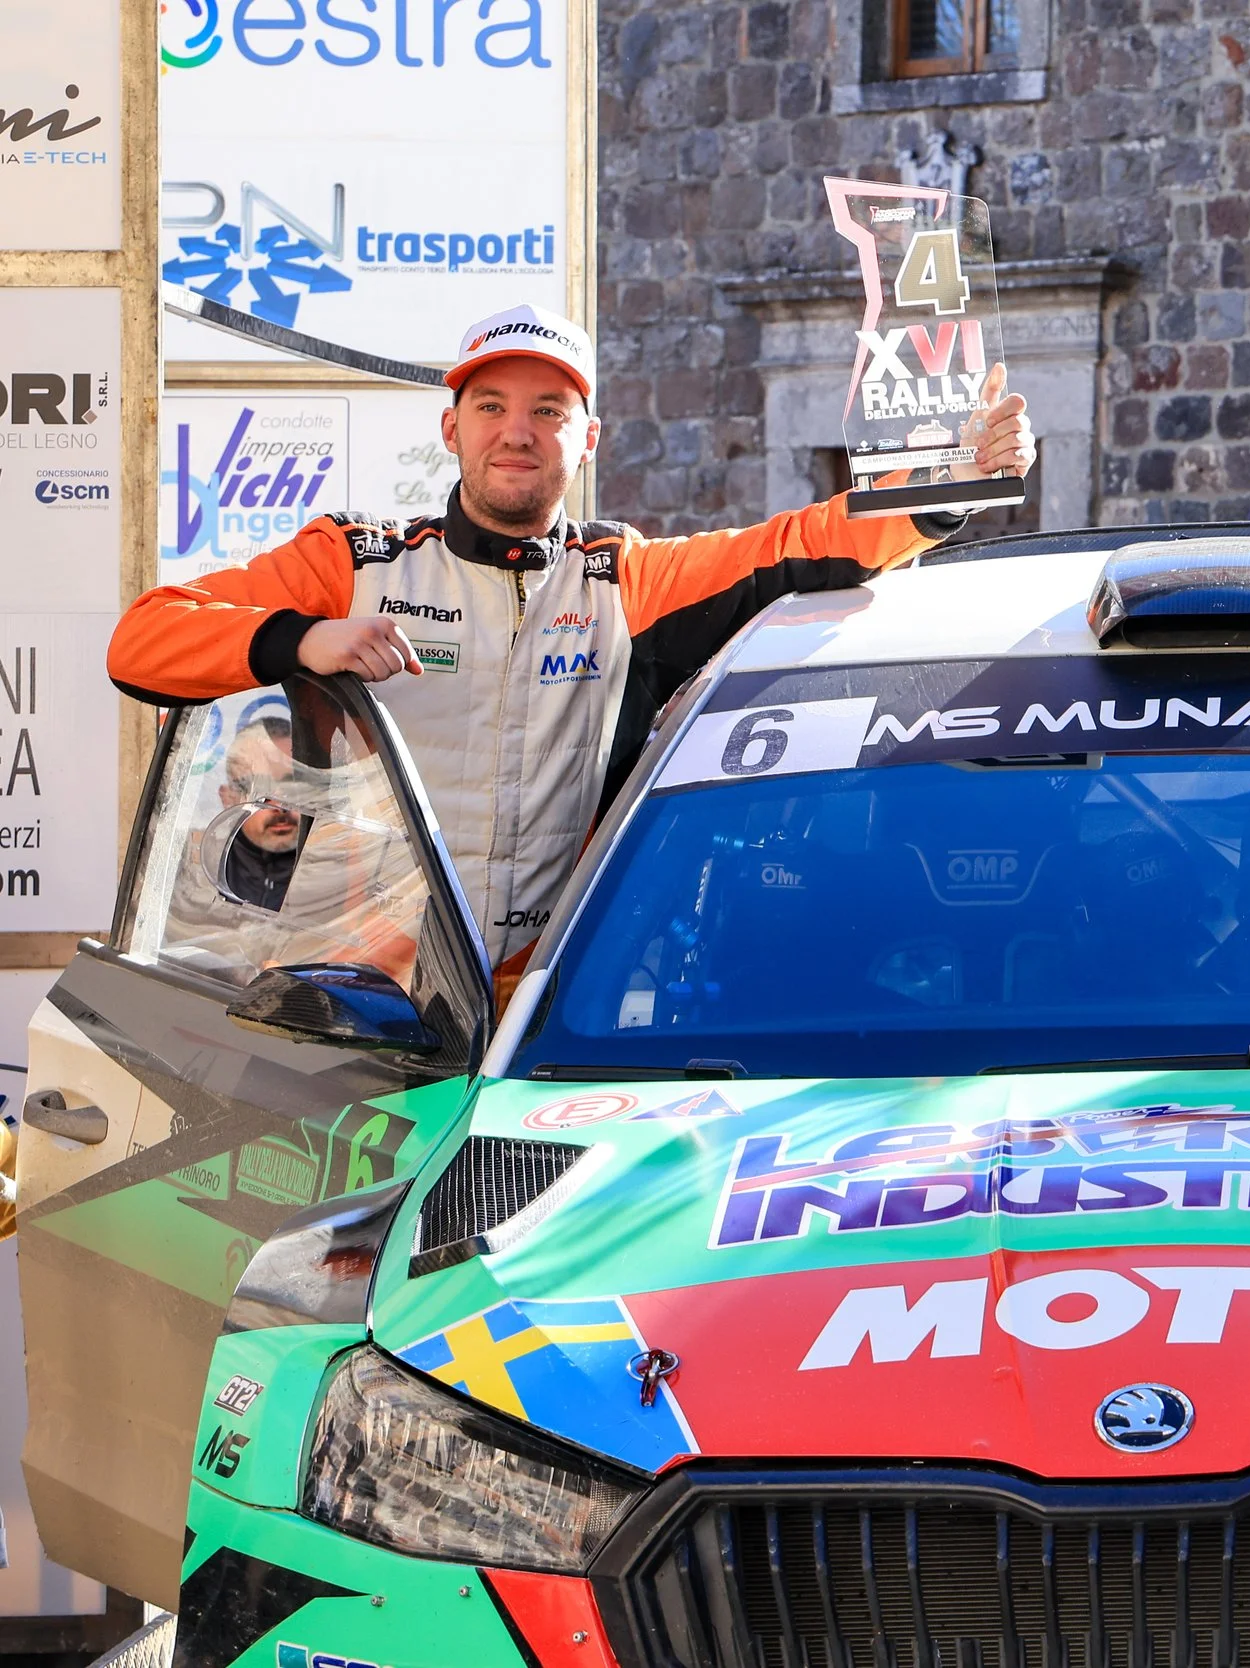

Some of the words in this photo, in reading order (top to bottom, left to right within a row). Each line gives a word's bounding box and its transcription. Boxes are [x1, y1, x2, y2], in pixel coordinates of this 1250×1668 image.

[232, 0, 553, 68] estra
[23, 152, 106, 164] E-TECH
[357, 225, 554, 272] trasporti
[894, 228, 970, 315] 4
[855, 319, 986, 383] XVI
[0, 373, 91, 425] RI
[98, 371, 108, 407] S.R.L.
[861, 372, 987, 413] RALLY
[260, 411, 334, 430] condotte
[864, 406, 905, 421] DELLA
[908, 403, 936, 417] VAL
[936, 400, 990, 415] D'ORCIA
[34, 432, 98, 449] LEGNO
[239, 436, 335, 463] impresa
[913, 450, 950, 461] ITALIANO
[951, 448, 976, 457] RALLY
[36, 469, 109, 478] CONCESSIONARIO
[60, 484, 110, 500] scm
[379, 595, 463, 623] haxman
[540, 649, 600, 677] MAK
[720, 709, 795, 776] 6
[861, 705, 1001, 746] MS
[0, 728, 41, 796] A
[947, 855, 1019, 881] OMP
[493, 909, 551, 928] JOHA
[197, 1424, 251, 1479] MS
